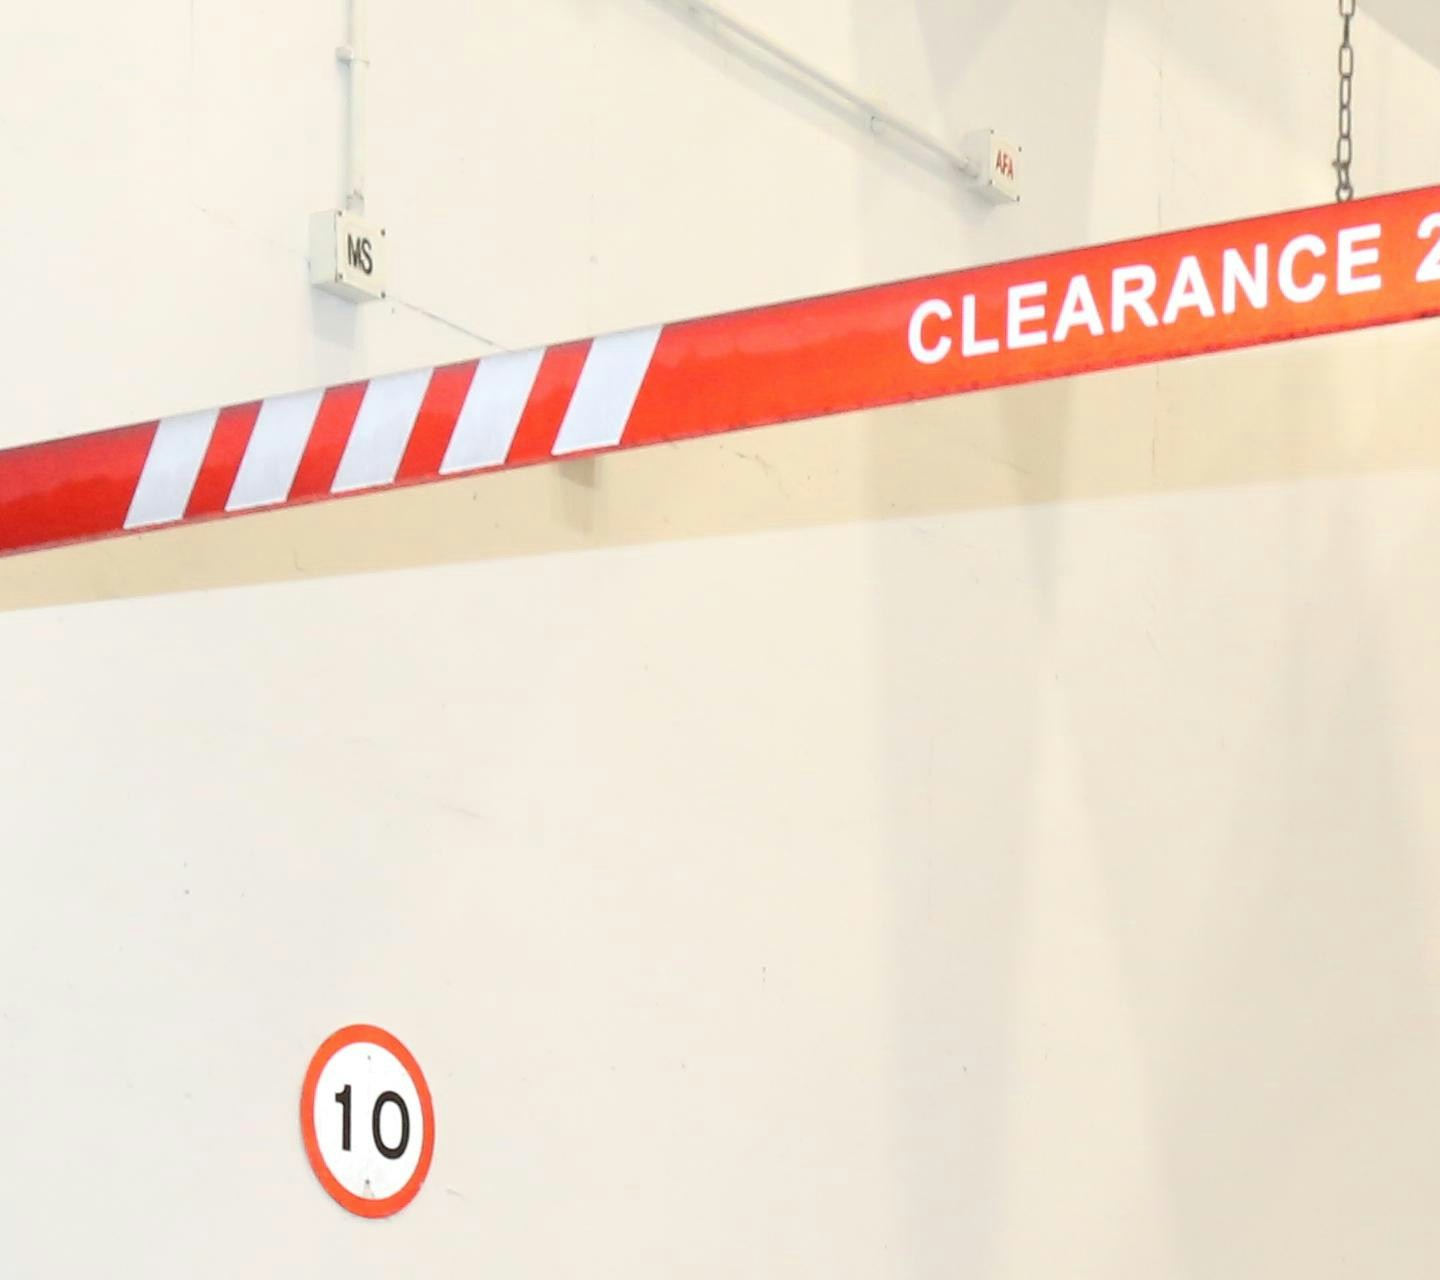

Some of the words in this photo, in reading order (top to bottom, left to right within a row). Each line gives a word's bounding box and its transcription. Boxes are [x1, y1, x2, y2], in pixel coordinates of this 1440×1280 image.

[994, 148, 1015, 181] AFA
[346, 232, 374, 275] MS
[907, 223, 1382, 365] CLEARANCE
[334, 1083, 411, 1161] 10
